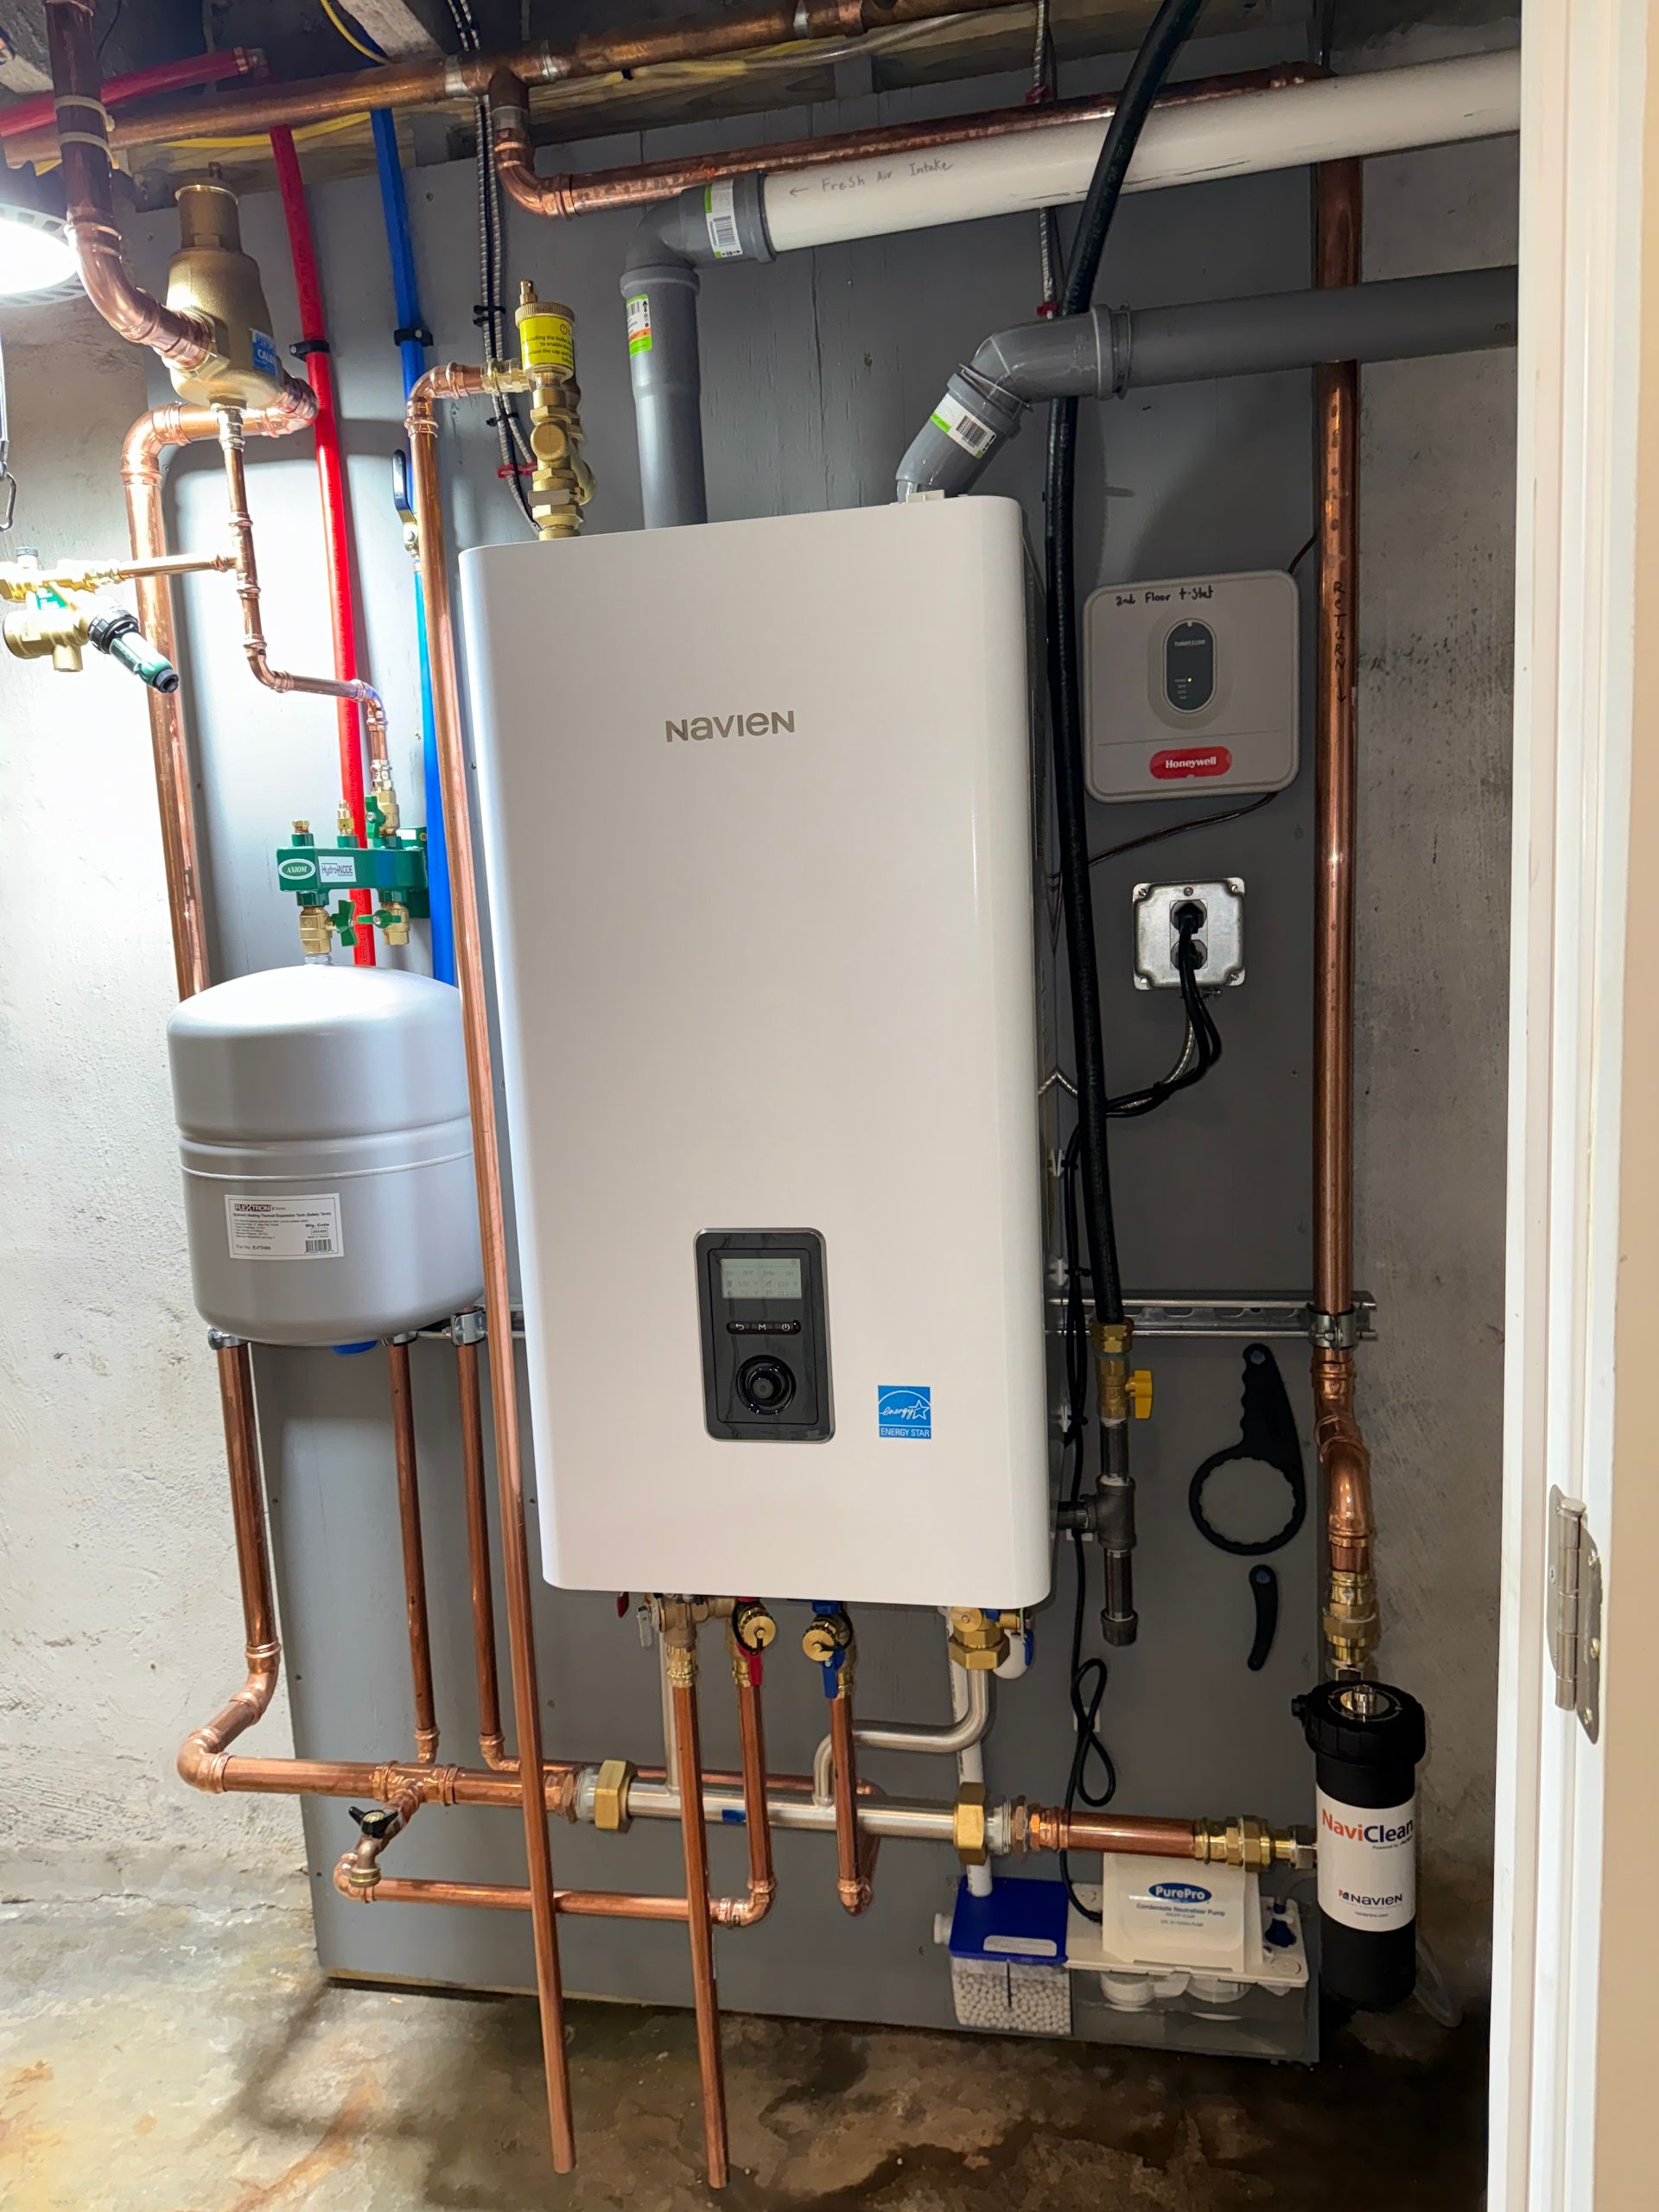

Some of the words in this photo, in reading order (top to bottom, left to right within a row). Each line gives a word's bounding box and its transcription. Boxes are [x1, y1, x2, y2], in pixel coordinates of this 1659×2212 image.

[877, 170, 893, 182] Air
[909, 158, 954, 176] Intake
[1116, 594, 1136, 607] 2nd
[1145, 591, 1171, 603] Floor
[1165, 756, 1217, 769] Honeywell
[286, 865, 308, 874] AXIOM
[880, 1427, 910, 1436] ENERGY
[911, 1428, 931, 1437] STAR
[1322, 1808, 1414, 1843] NaviClean
[1155, 1885, 1206, 1900] PurePro
[1207, 1908, 1225, 1916] Pump
